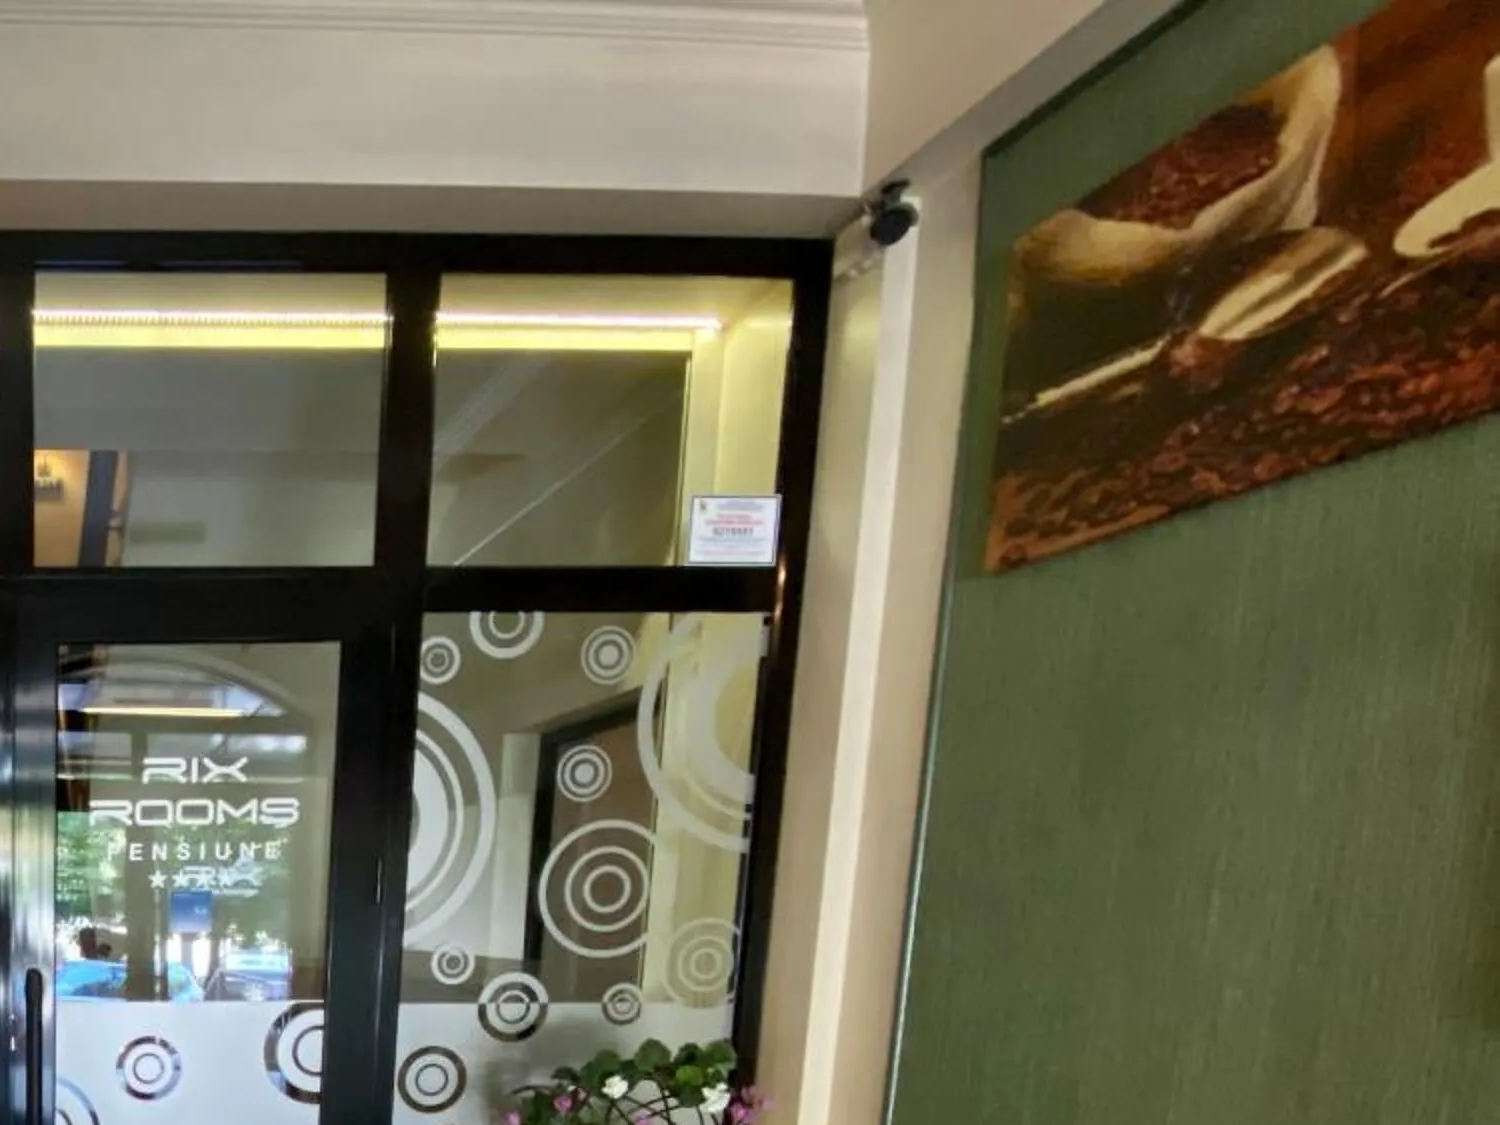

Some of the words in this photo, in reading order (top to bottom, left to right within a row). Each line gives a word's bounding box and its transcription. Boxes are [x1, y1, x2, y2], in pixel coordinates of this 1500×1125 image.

[142, 756, 248, 784] RIX
[89, 797, 300, 827] ROOMS
[107, 842, 282, 861] PENSIUNE
